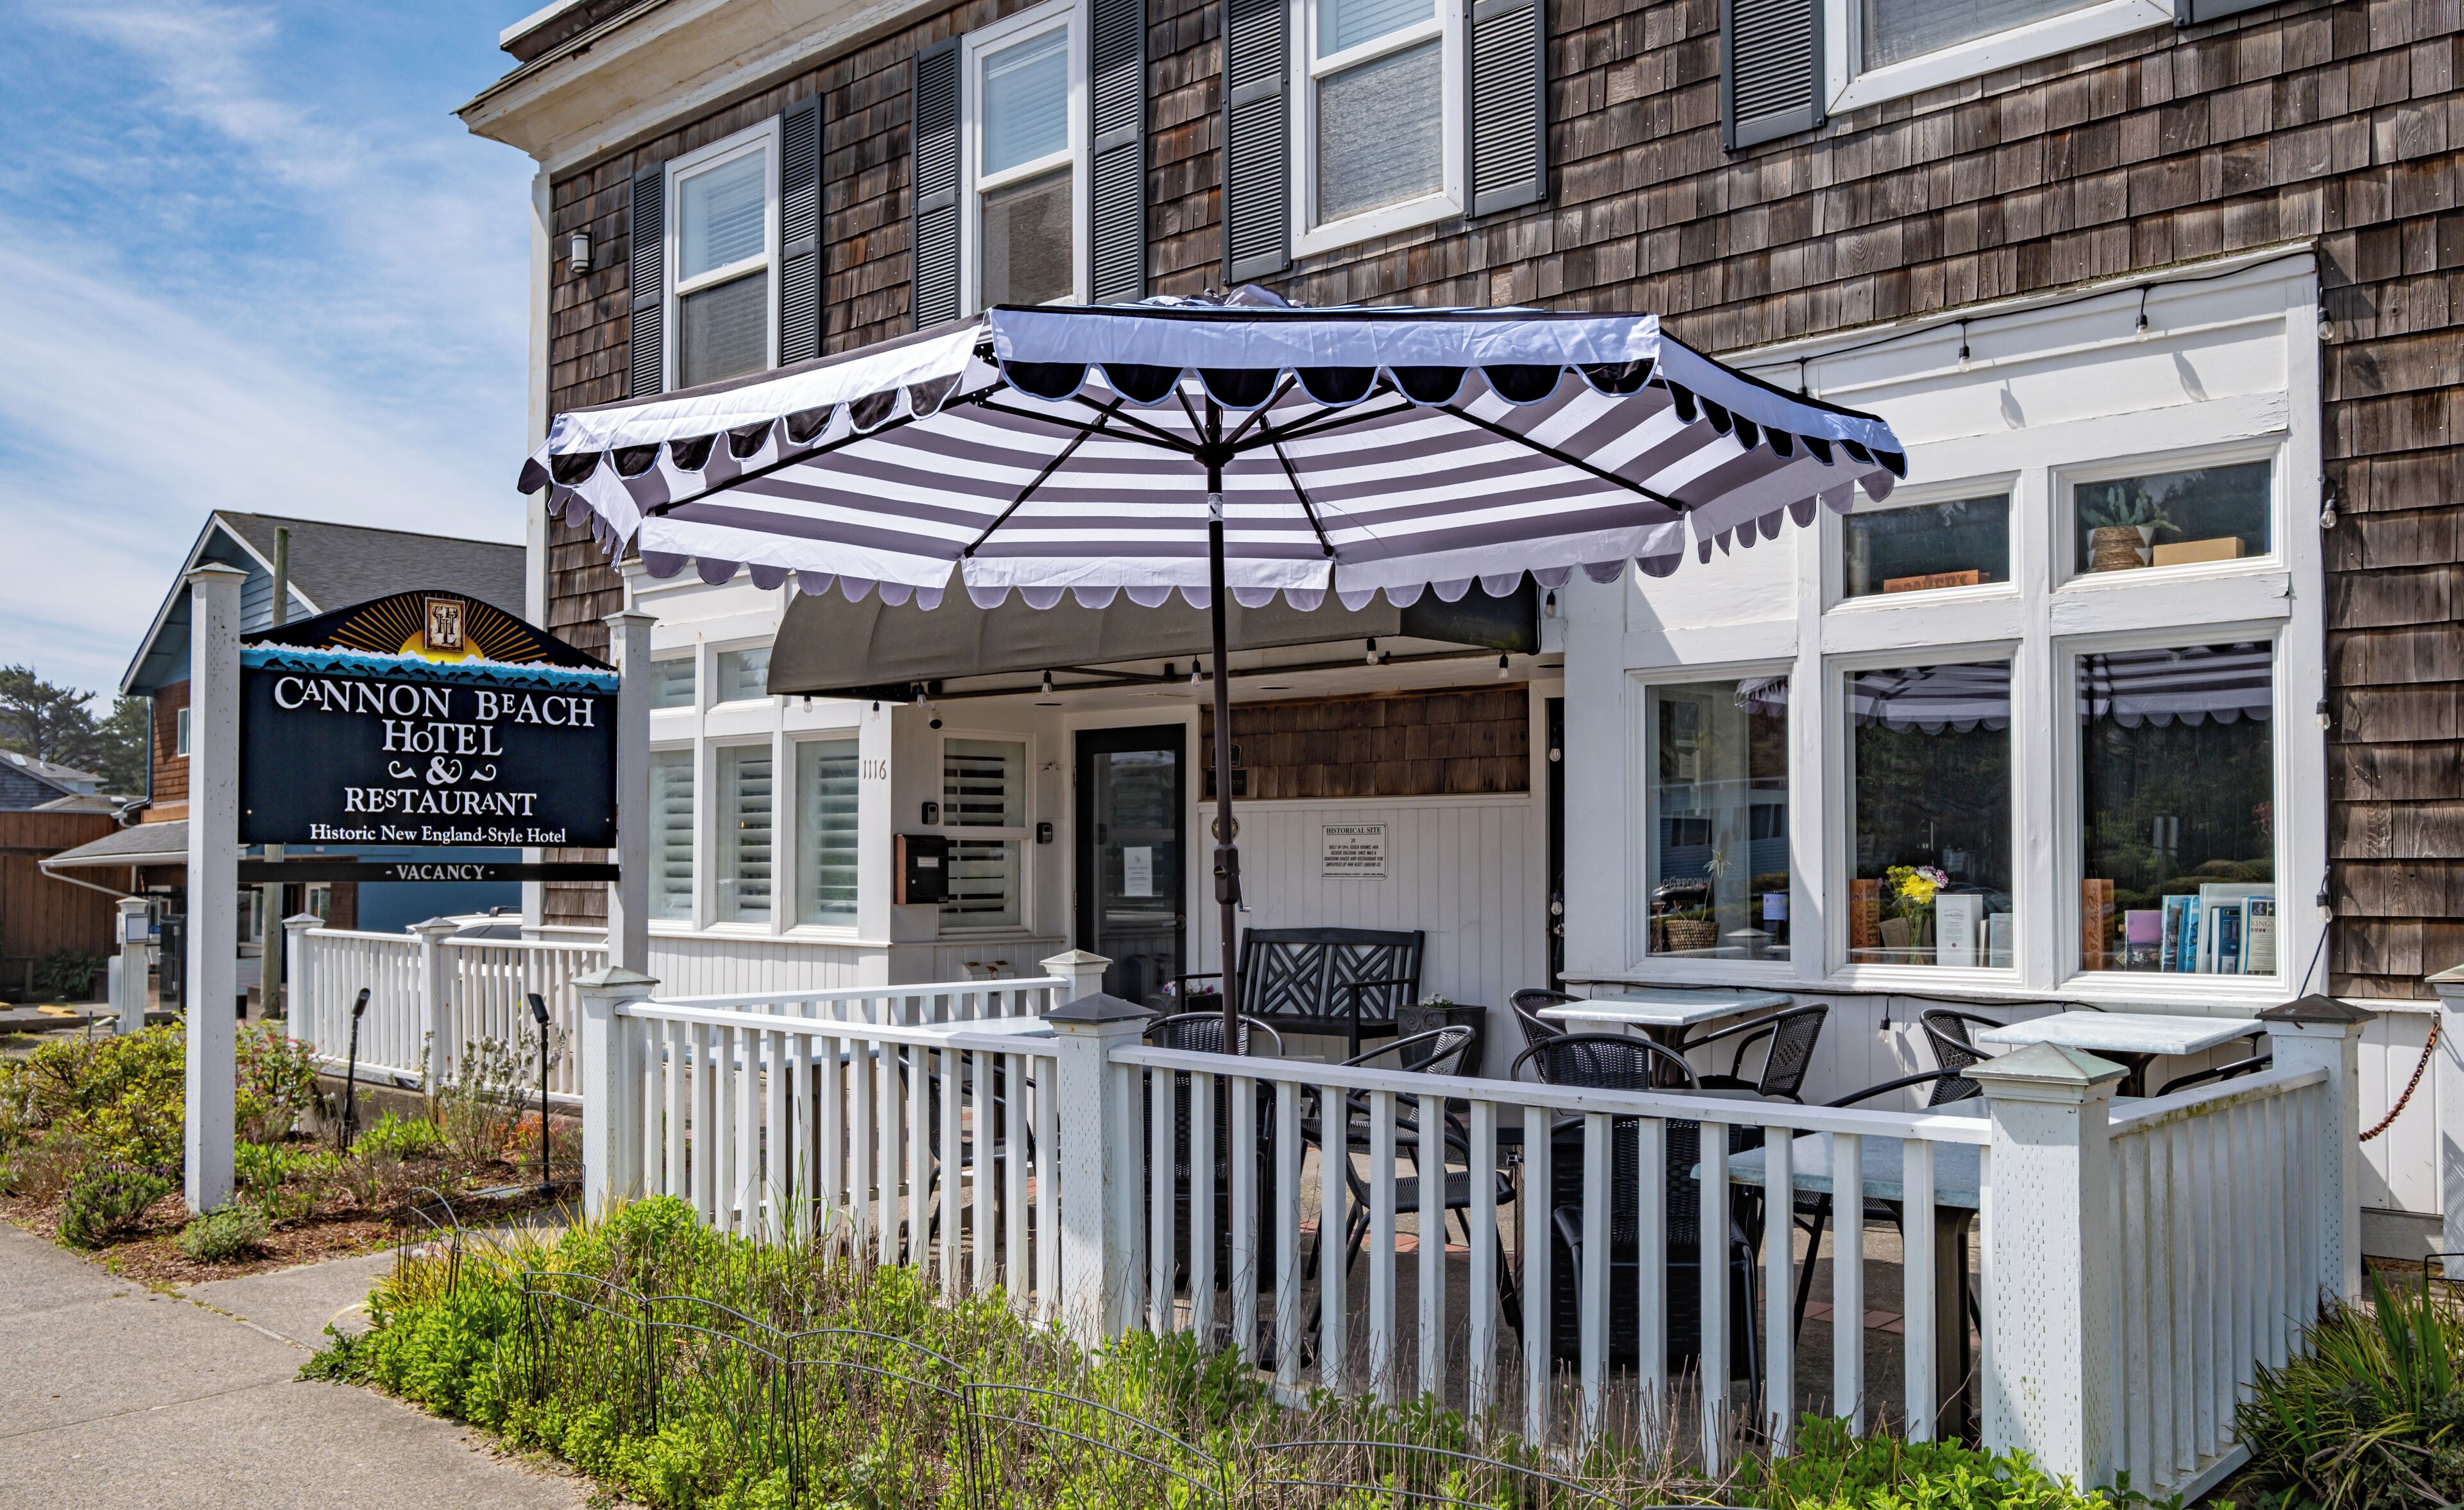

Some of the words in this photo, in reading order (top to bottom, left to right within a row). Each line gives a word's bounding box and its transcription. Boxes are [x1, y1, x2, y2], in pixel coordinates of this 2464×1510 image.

[274, 676, 452, 719] CANNON
[475, 689, 595, 727] BEACH
[382, 719, 503, 757] HOTEL
[426, 756, 463, 786] &
[864, 759, 887, 780] 1116
[345, 787, 537, 816] RESTAURANT
[310, 823, 376, 842] Historic
[381, 826, 418, 842] New
[422, 827, 523, 845] England-Style
[527, 828, 566, 843] Hotel
[397, 864, 485, 880] VACANCY
